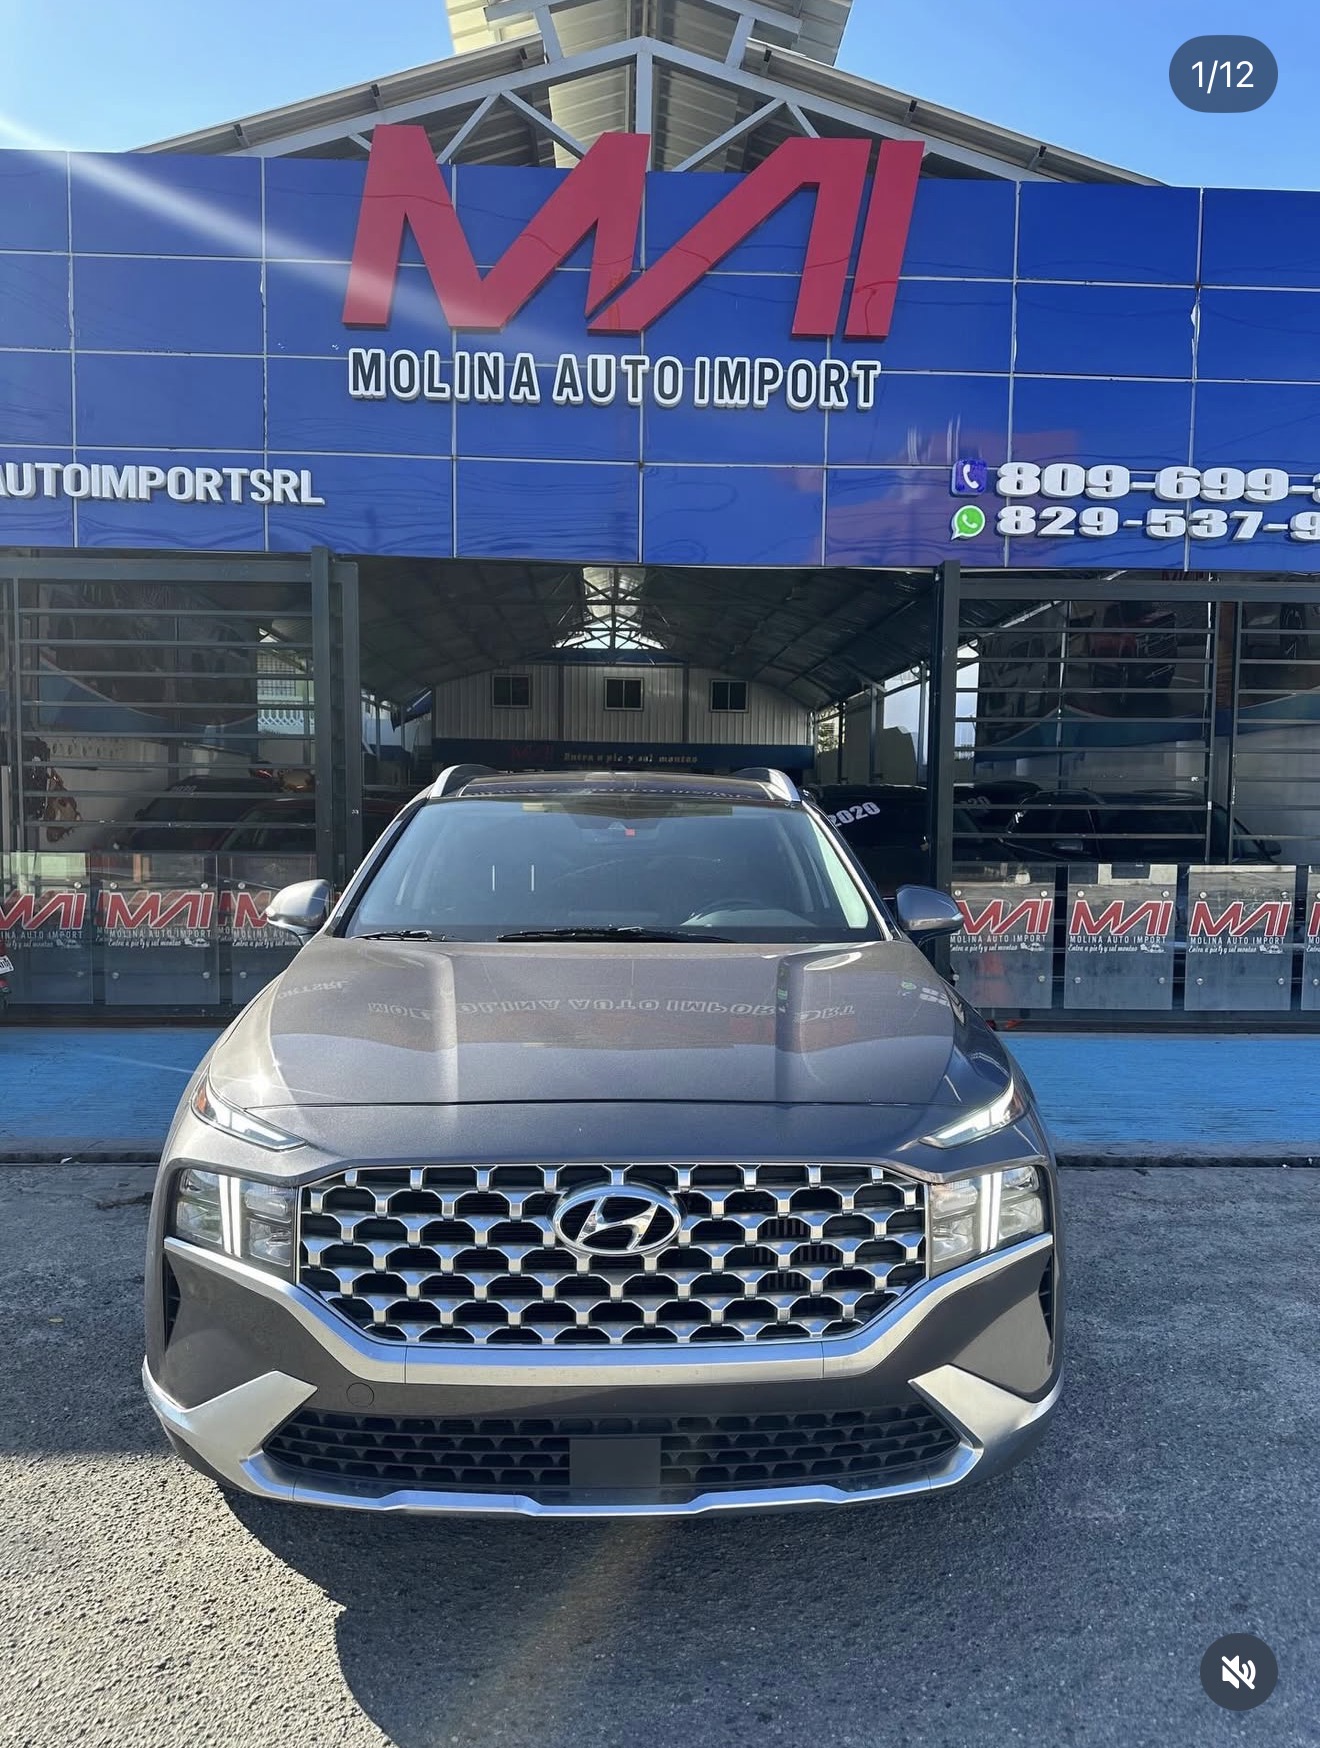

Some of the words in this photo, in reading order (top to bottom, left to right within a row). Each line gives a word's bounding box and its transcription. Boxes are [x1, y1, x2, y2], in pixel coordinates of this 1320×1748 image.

[342, 124, 924, 340] MAI
[349, 348, 541, 404] MOLINA
[552, 354, 683, 407] AUTO
[694, 357, 881, 411] IMPORT
[996, 462, 1320, 502] 809-699-
[109, 929, 145, 938] MOLINA
[149, 930, 173, 938] AUTO
[177, 930, 212, 938] IMPORT
[1069, 900, 1174, 936] MAI
[1188, 901, 1292, 937] MAI
[950, 935, 983, 943] MOLINA
[987, 935, 1009, 943] AUTO
[1013, 935, 1046, 943] IMPORT
[1069, 935, 1103, 944] MOLINA
[1106, 935, 1129, 944] AUTO
[1133, 936, 1167, 944] IMPORT
[1190, 936, 1222, 945] MOLINA
[1226, 937, 1249, 945] AUTO
[1252, 937, 1285, 945] IMPORT
